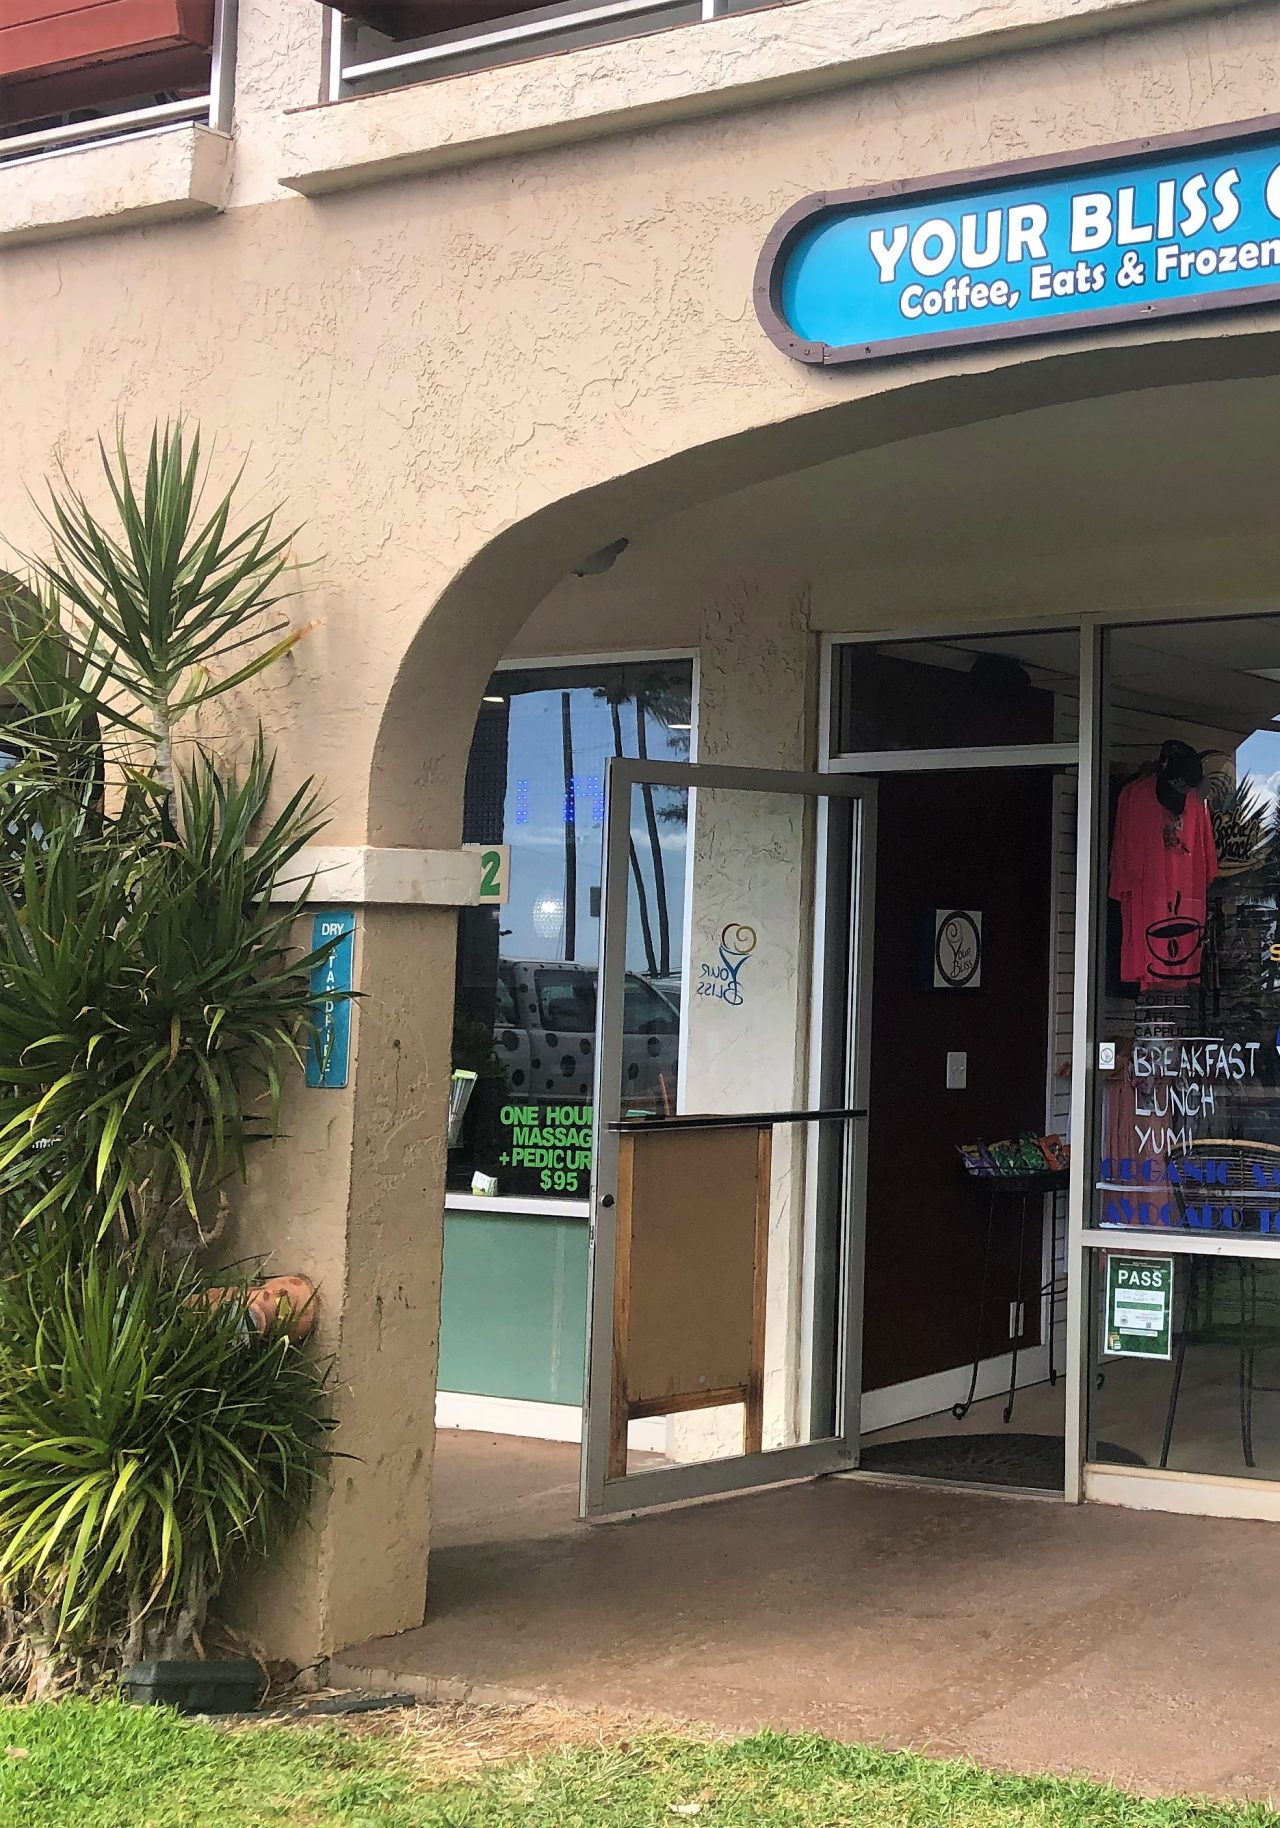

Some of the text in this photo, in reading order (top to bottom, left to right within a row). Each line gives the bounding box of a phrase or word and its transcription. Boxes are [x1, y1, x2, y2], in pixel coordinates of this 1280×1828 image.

[869, 202, 1048, 284] YOUR
[1070, 167, 1242, 254] BLISS
[900, 275, 1020, 319] Coffee,
[1029, 260, 1106, 301] Eats
[1116, 249, 1146, 289] &
[321, 922, 345, 936] DRY
[1133, 1042, 1261, 1080] BREAKFAST
[1134, 1083, 1216, 1118] LUNCH
[500, 1106, 540, 1126] ONE
[540, 1168, 579, 1192] $95
[1118, 1269, 1163, 1288] PASS
